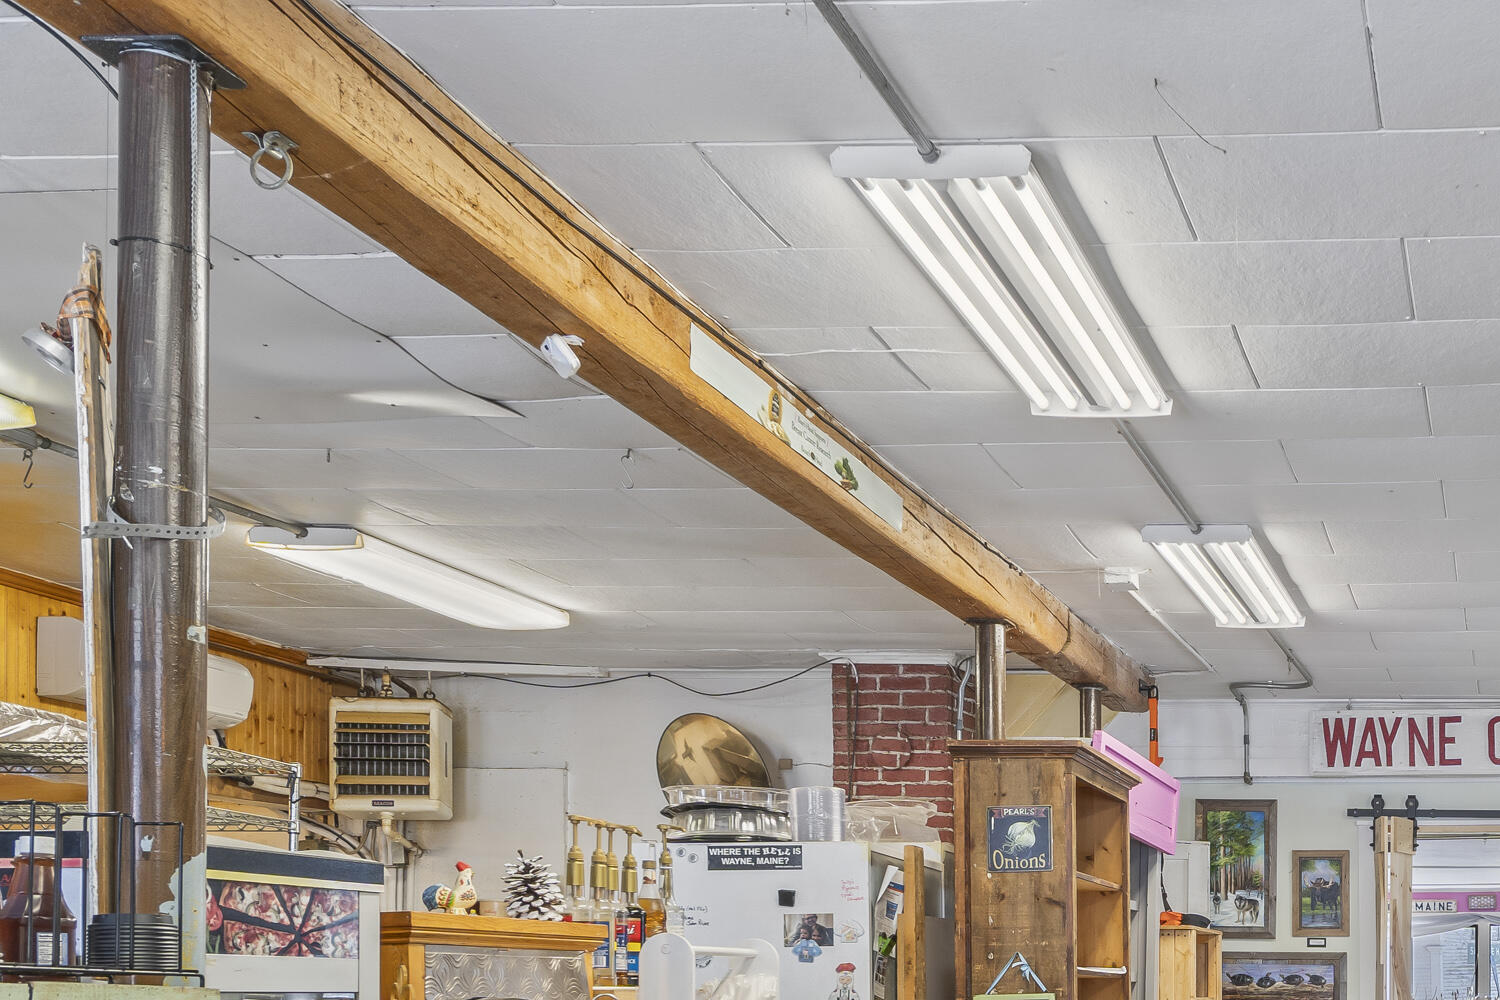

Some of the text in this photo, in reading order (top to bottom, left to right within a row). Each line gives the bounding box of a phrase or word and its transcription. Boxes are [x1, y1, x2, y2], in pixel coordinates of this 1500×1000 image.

[1322, 716, 1462, 767] WAYNE
[709, 847, 802, 856] WHERE THE HELL IS
[721, 857, 790, 866] WAYNE, MAINE?
[992, 849, 1046, 870] Onions
[1415, 901, 1453, 911] MAINE
